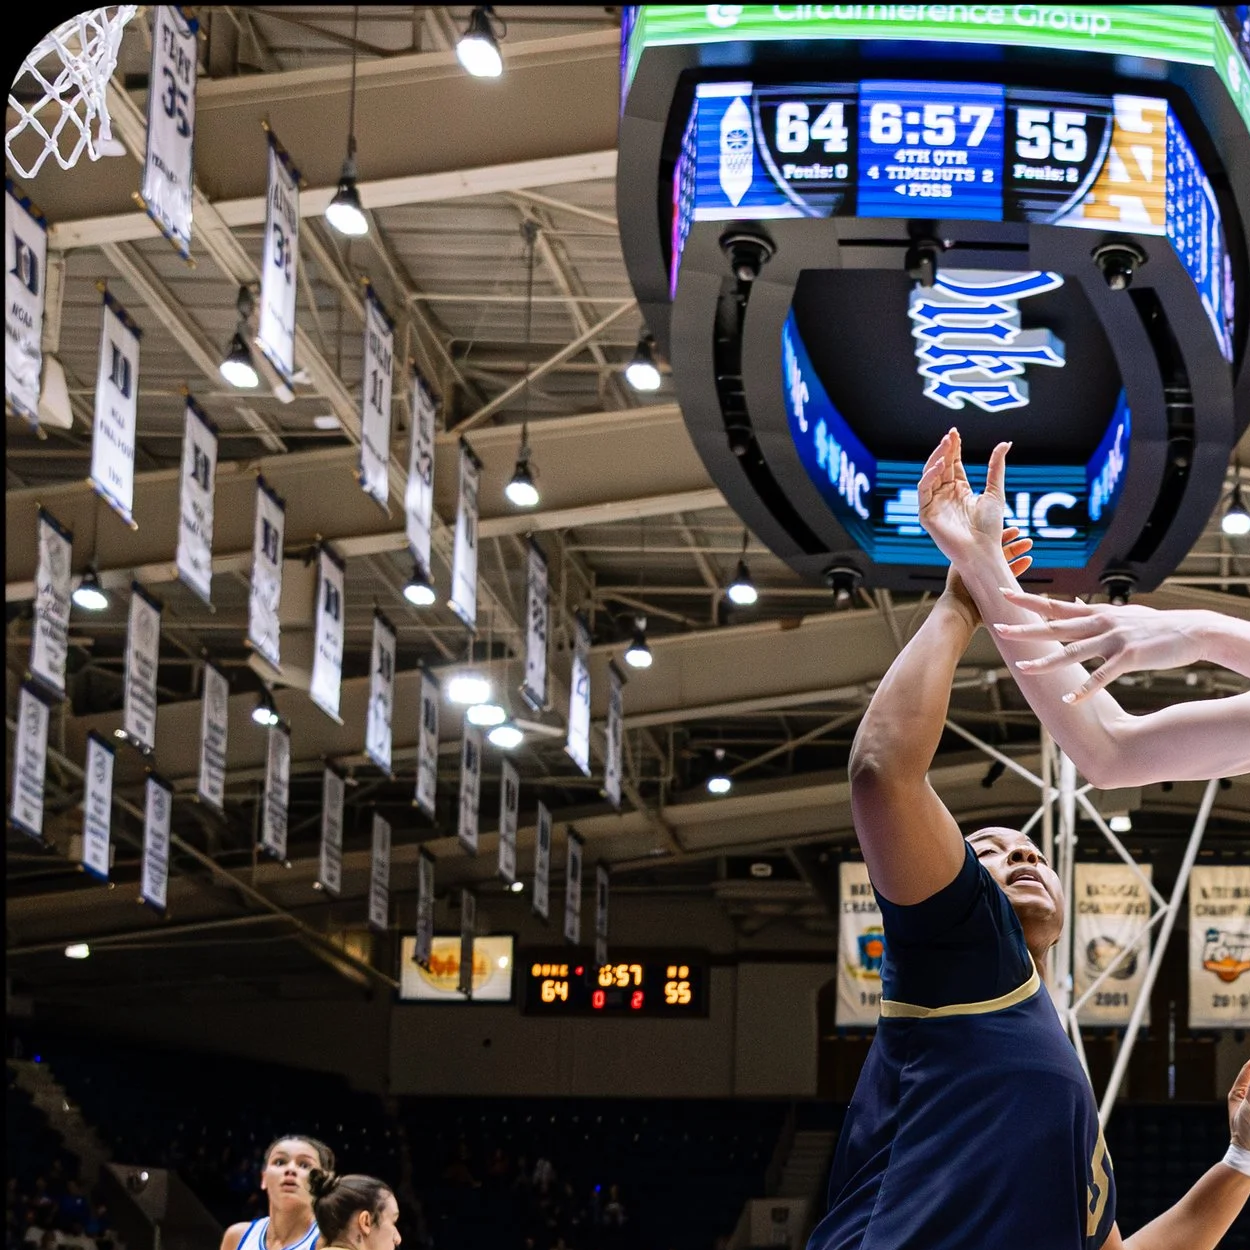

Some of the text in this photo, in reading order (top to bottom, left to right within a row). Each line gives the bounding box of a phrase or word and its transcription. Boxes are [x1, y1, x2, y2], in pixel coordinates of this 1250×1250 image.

[1012, 5, 1111, 38] Group
[162, 66, 191, 139] 35
[776, 101, 848, 153] 64
[869, 102, 994, 147] 6:57
[1015, 108, 1088, 162] 55
[894, 149, 967, 167] 4TH QTR
[782, 163, 833, 179] Fouls:
[867, 166, 994, 183] 4 TIMEOUTS 2
[1013, 164, 1064, 181] Fouls:
[908, 183, 952, 198] POSS
[598, 963, 642, 987] 6:57
[541, 980, 569, 1002] 64
[592, 990, 605, 1009] 0
[664, 981, 691, 1004] 55
